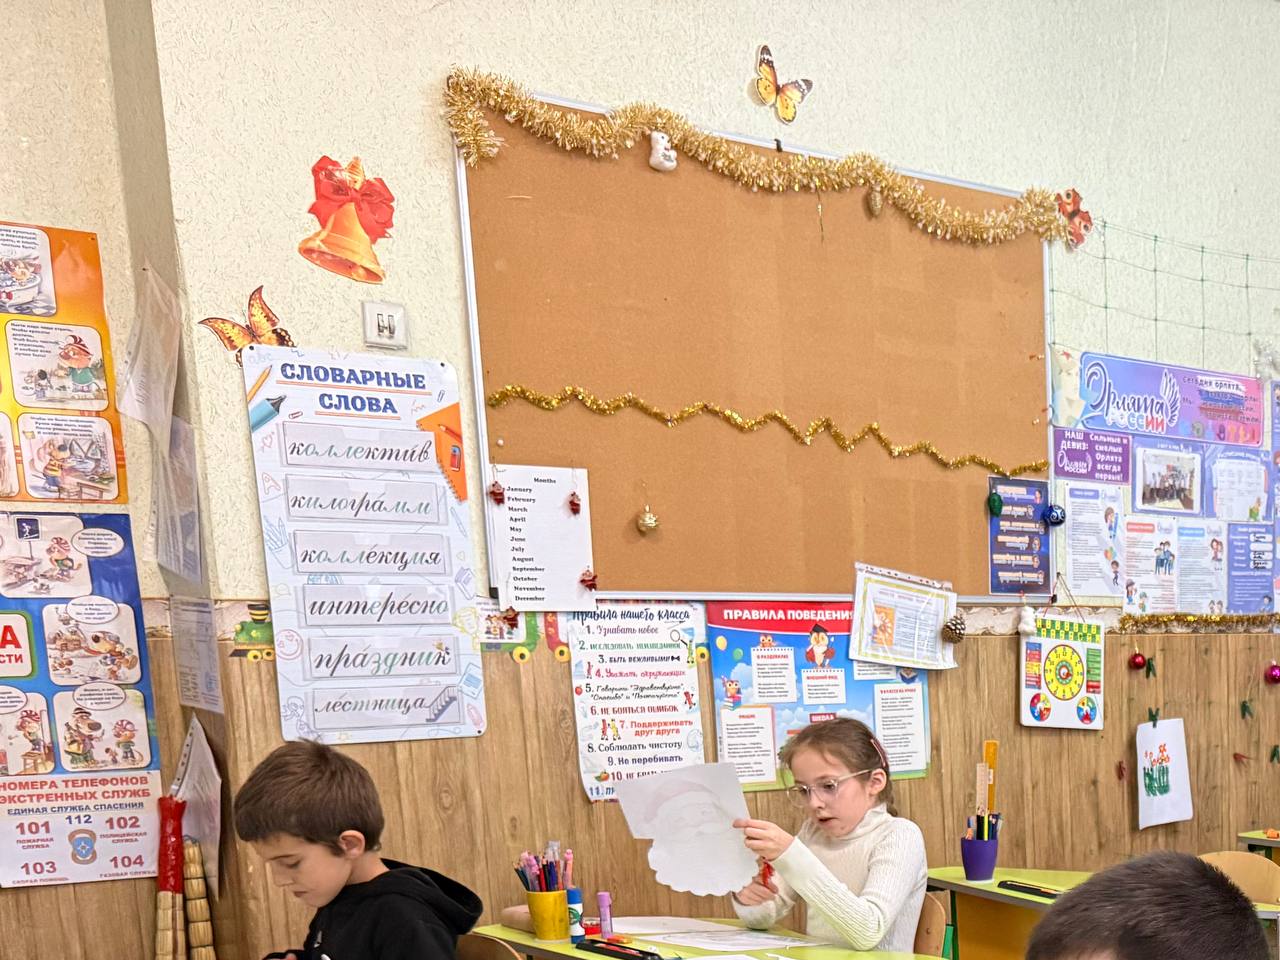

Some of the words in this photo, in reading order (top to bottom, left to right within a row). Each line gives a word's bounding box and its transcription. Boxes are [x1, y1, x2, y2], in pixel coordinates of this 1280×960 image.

[280, 363, 426, 390] СЛОВАРНЫЕ
[1085, 361, 1166, 416] Орлята
[319, 393, 398, 414] СЛОВА
[1106, 411, 1167, 434] РОССИИ
[1064, 431, 1084, 441] НАШ
[1089, 434, 1122, 444] Сильные
[1060, 440, 1089, 451] ДЕВИЗ:
[1095, 445, 1123, 453] смелые
[1095, 454, 1123, 464] Орлята
[1096, 465, 1121, 473] всегда
[1095, 472, 1123, 482] первые!
[506, 486, 533, 494] January
[507, 496, 536, 504] February
[572, 611, 618, 626] Правила
[620, 608, 655, 621] нашего
[657, 609, 690, 621] класса
[724, 609, 786, 621] ПРАВИЛА
[596, 625, 637, 637] Узнавать
[612, 706, 646, 715] БОЯТЬСЯ
[647, 704, 679, 714] ОШИБОК
[630, 720, 694, 729] Поддерживать
[634, 729, 653, 737] друг
[655, 728, 681, 736] друга
[598, 743, 647, 753] Соблюдать
[648, 741, 682, 749] чистоту
[618, 757, 630, 765] Не
[631, 755, 683, 765] перебивать
[62, 776, 148, 789] ТЕЛЕФОНОВ
[0, 791, 97, 805] ЭКСТРЕННЫХ
[102, 788, 150, 799] СЛУЖБ
[7, 807, 48, 816] ЕДИНАЯ
[51, 804, 90, 813] СЛУЖБА
[94, 802, 144, 810] СПАСЕНИЯ
[65, 815, 93, 825] 112
[105, 816, 141, 830] 102
[16, 821, 50, 835] 101
[109, 855, 144, 868] 104
[20, 861, 57, 875] 103
